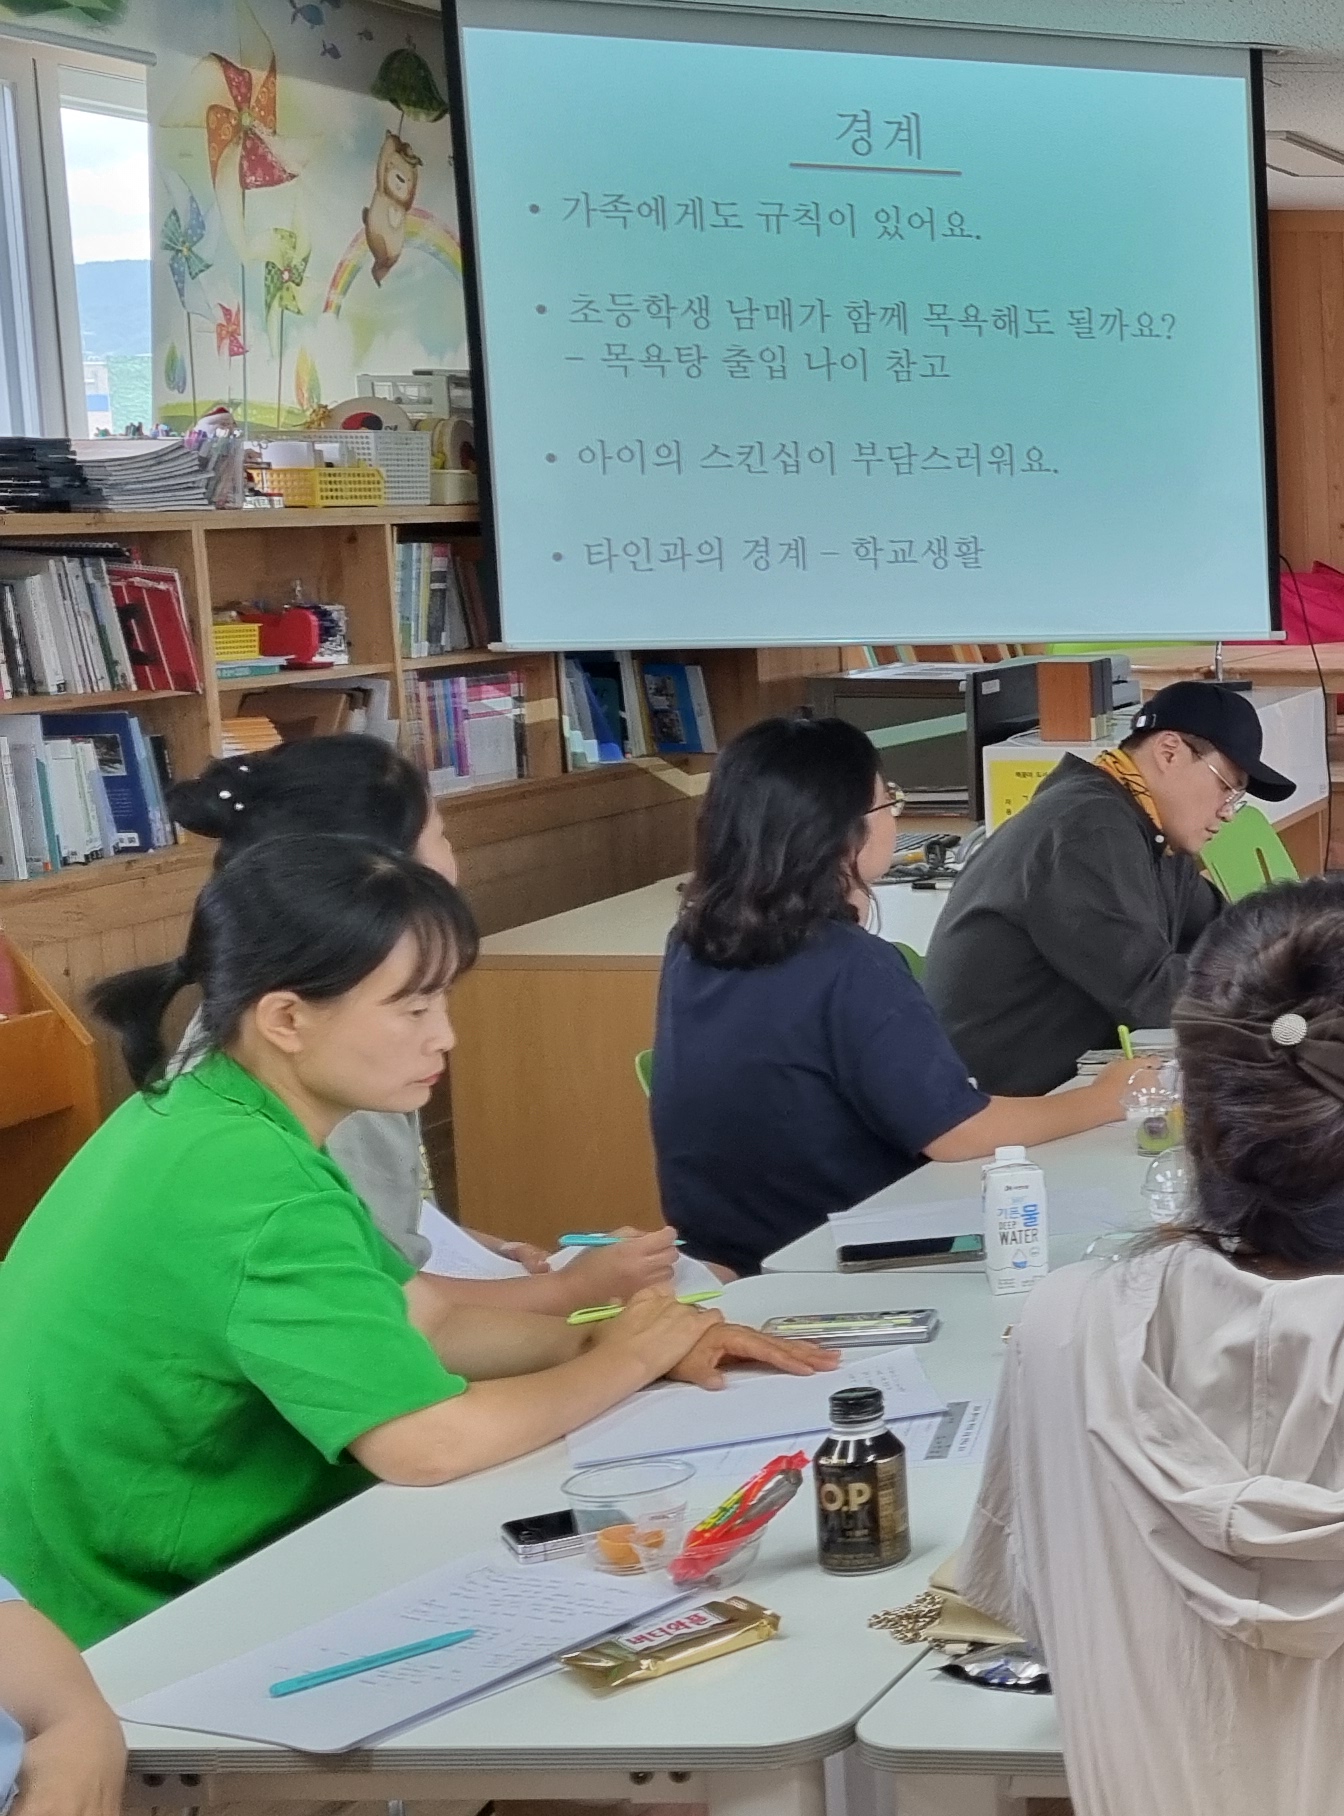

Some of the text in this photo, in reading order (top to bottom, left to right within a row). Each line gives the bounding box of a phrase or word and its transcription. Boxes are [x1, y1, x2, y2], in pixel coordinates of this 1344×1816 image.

[835, 108, 925, 161] 경계
[561, 191, 982, 242] 가족에게도 규칙이 있어요.
[568, 292, 1178, 342] 초등학생 남매가 함께 목욕해도 될까요?
[601, 341, 708, 382] 목욕탕
[722, 343, 787, 383] 출입
[803, 347, 868, 383] 나이
[885, 347, 951, 384] 참고
[577, 440, 1060, 478] 아이의 스킨십이 부담스러워요.
[584, 537, 725, 574] 타인과의
[742, 537, 809, 573] 경계
[852, 535, 985, 571] 학교생활
[999, 1221, 1017, 1230] DEEP
[999, 1229, 1039, 1245] WATER
